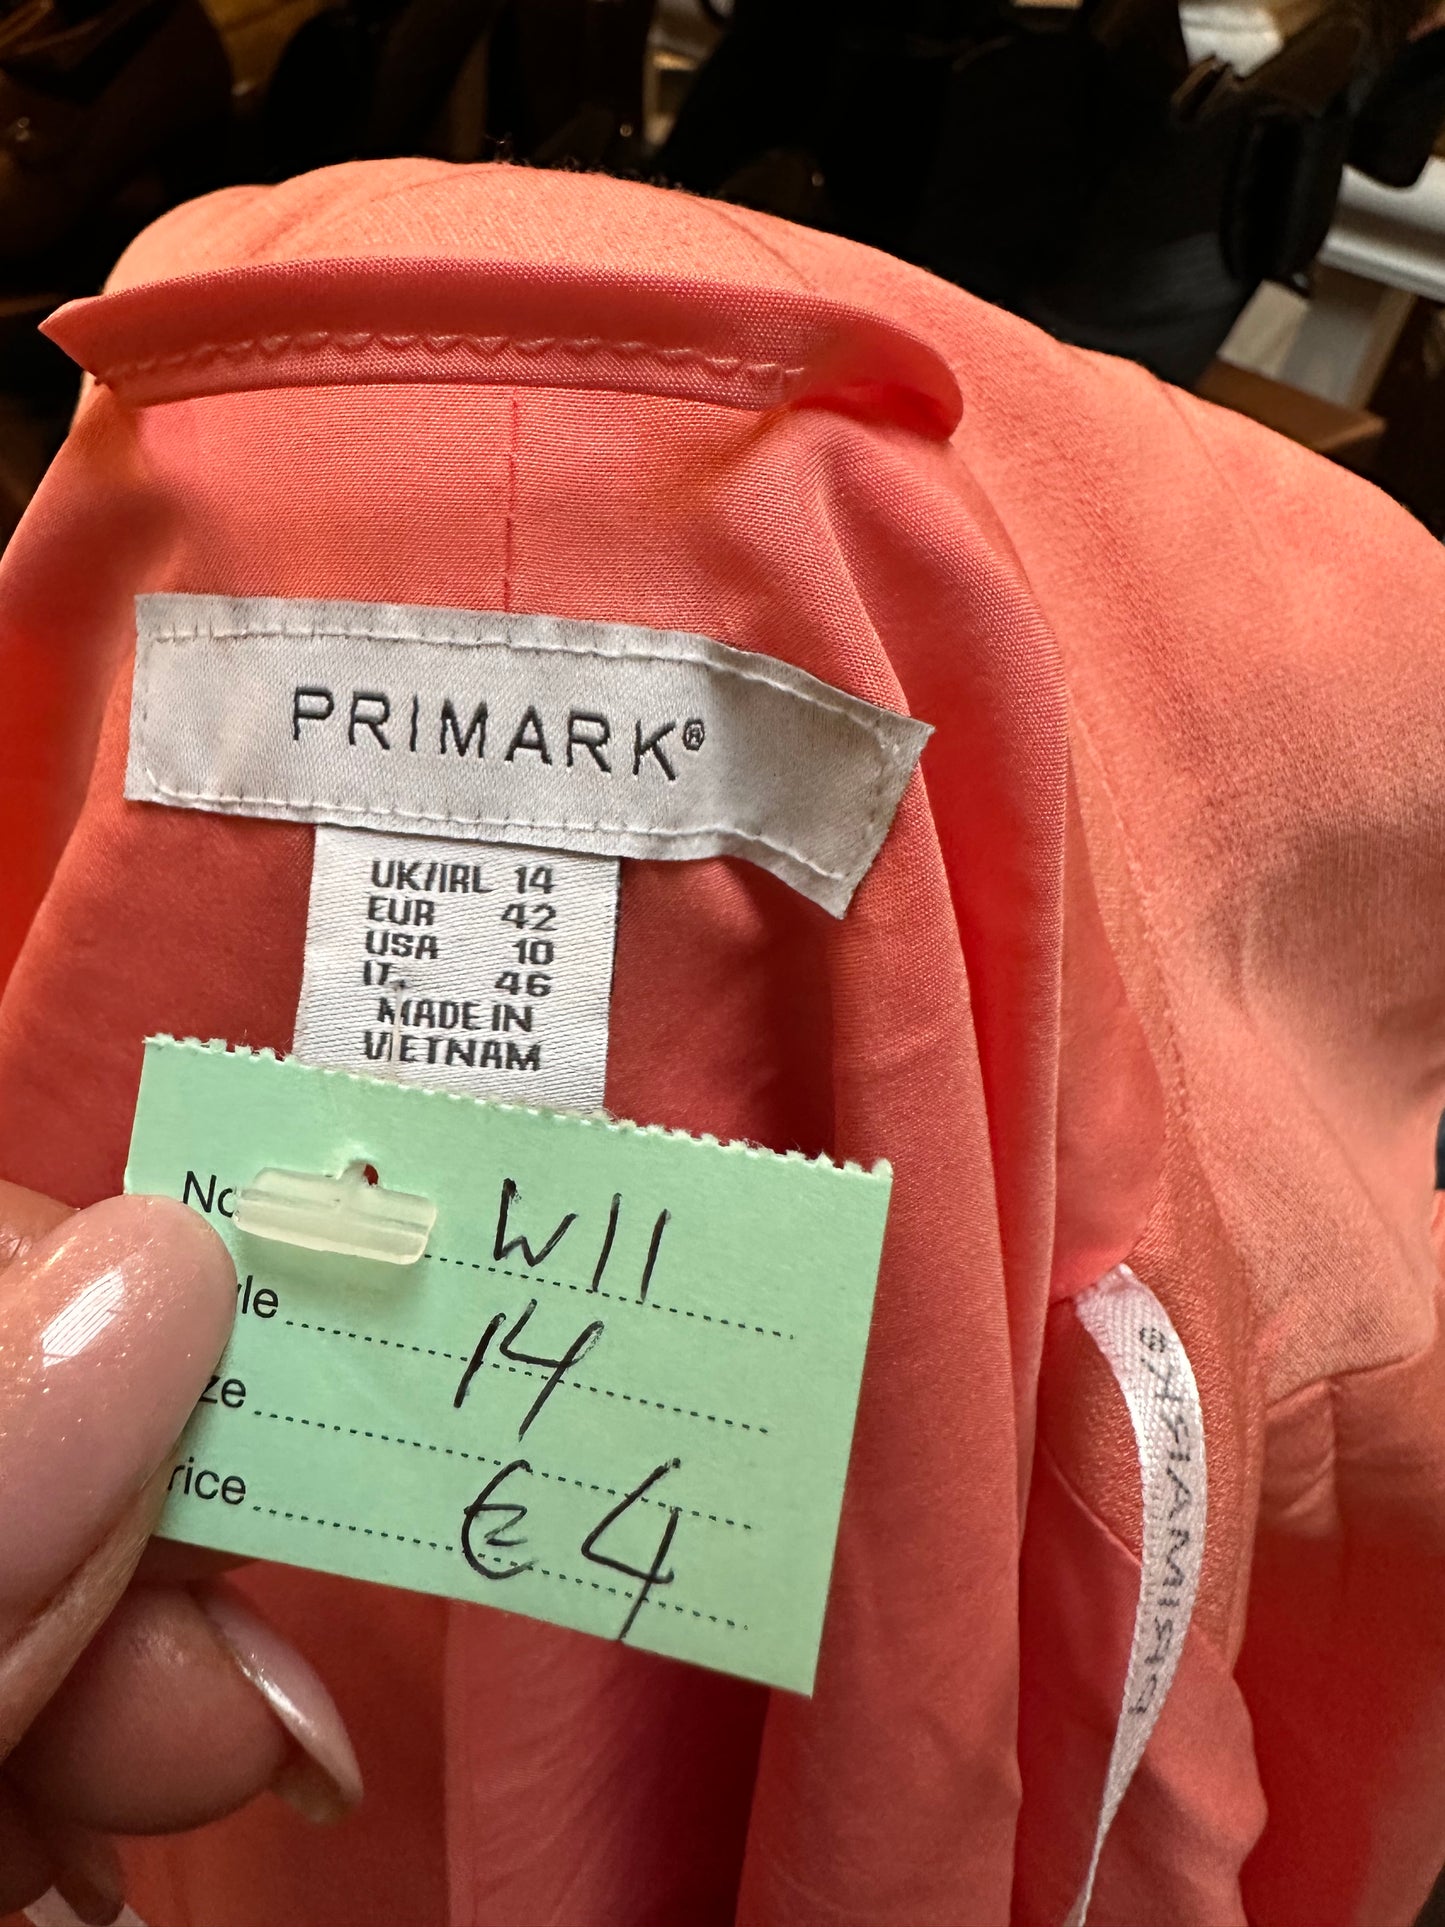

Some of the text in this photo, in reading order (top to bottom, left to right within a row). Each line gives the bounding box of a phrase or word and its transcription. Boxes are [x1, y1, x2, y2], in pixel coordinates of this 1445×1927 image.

[370, 859, 554, 894] UK/IRL 14
[367, 896, 557, 931] EUR 42
[365, 931, 554, 965] USA 10
[495, 971, 552, 997] 46
[377, 999, 533, 1032] MADE IN
[453, 1299, 605, 1442] 14
[199, 1375, 247, 1409] ze
[167, 1456, 247, 1506] rice
